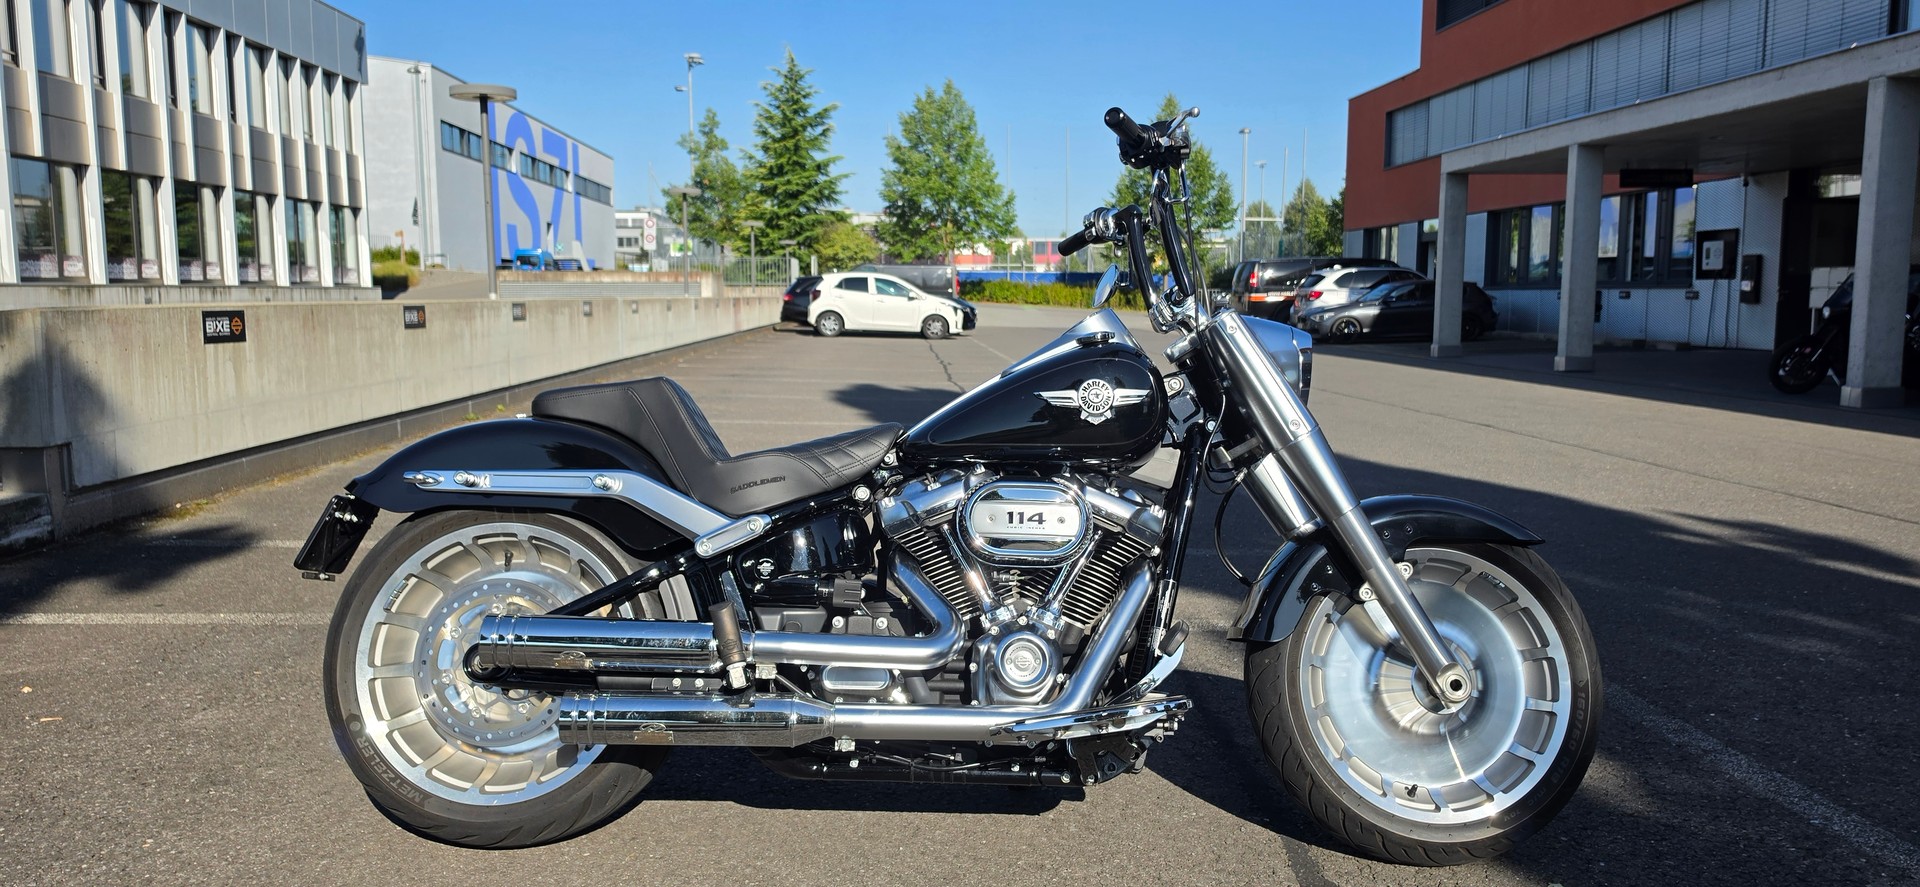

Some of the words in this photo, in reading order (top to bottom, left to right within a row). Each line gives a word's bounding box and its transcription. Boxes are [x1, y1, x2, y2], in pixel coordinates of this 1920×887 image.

[1082, 380, 1110, 393] HARLEY
[1081, 396, 1111, 412] DAVIDSON
[1007, 511, 1046, 524] 114
[357, 736, 424, 803] METZELER
